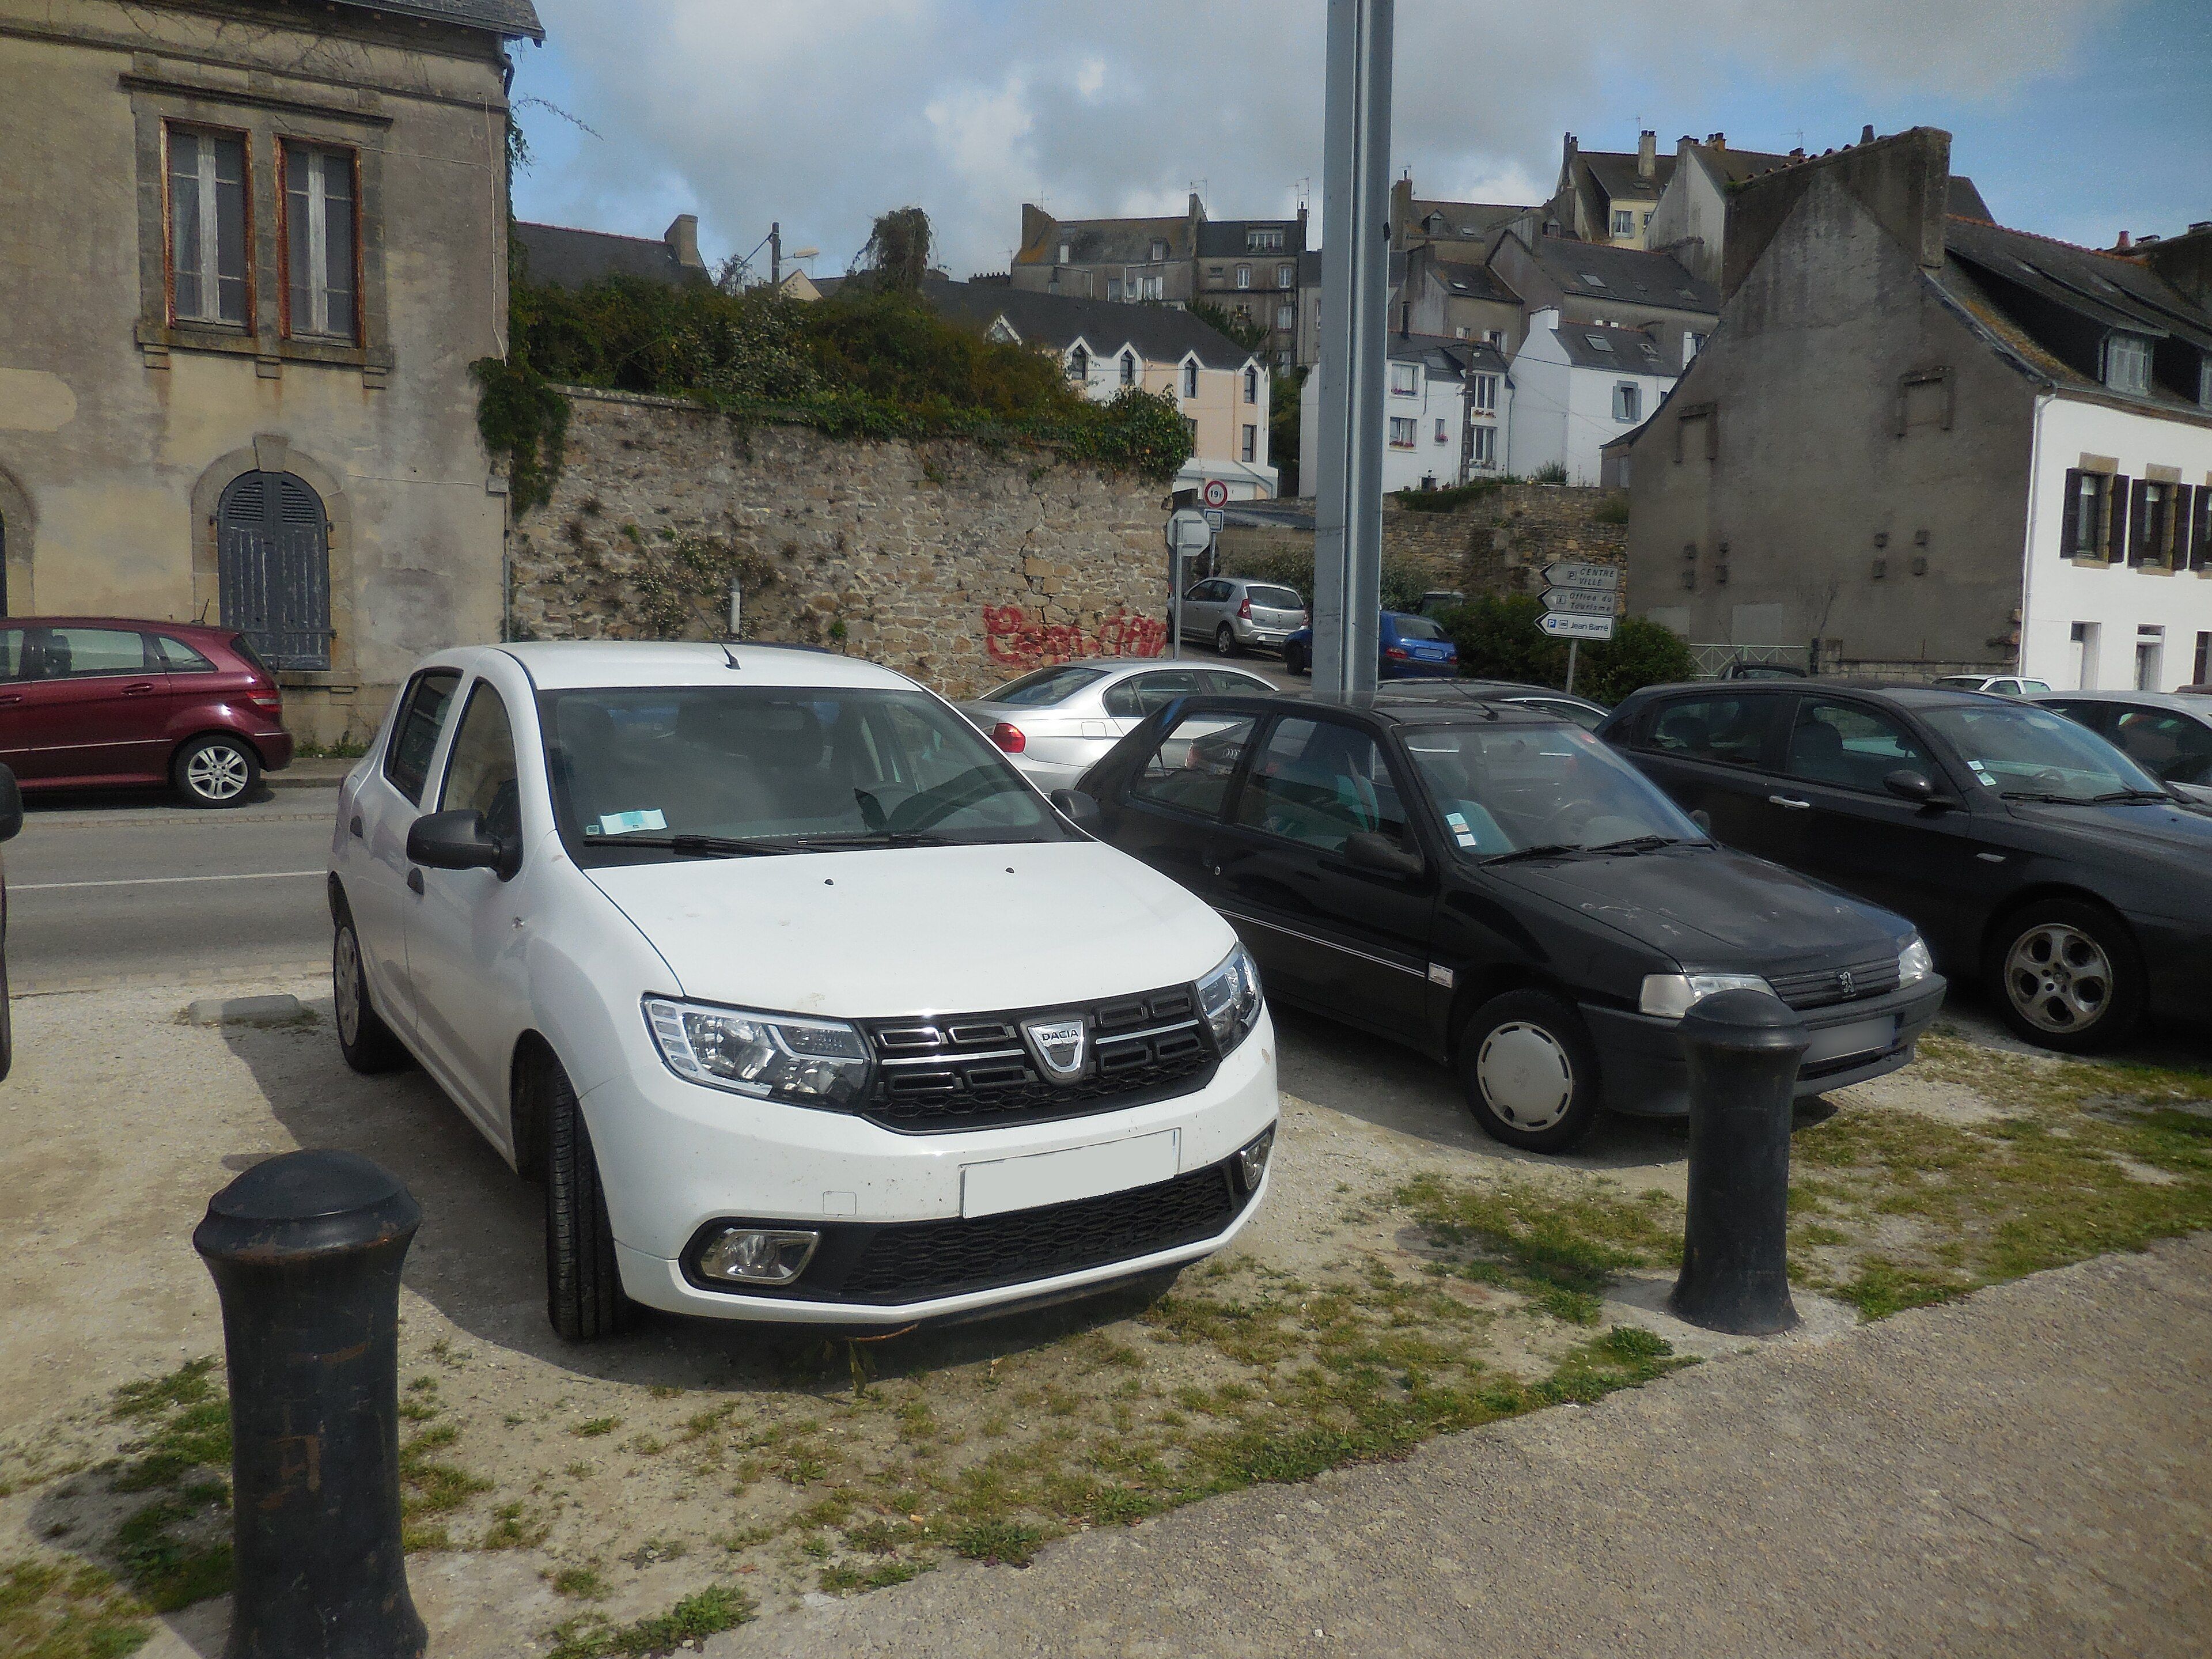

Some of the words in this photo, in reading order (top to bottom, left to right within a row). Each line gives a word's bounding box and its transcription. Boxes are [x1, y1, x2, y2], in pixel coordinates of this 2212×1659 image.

[1580, 568, 1614, 577] CENTRE
[1580, 578, 1602, 586] VILLE
[1569, 592, 1596, 601] Office
[1570, 602, 1611, 612] Tourisme
[1570, 622, 1587, 630] Jean
[1588, 623, 1609, 631] Barré
[1041, 1029, 1079, 1041] DACIA
